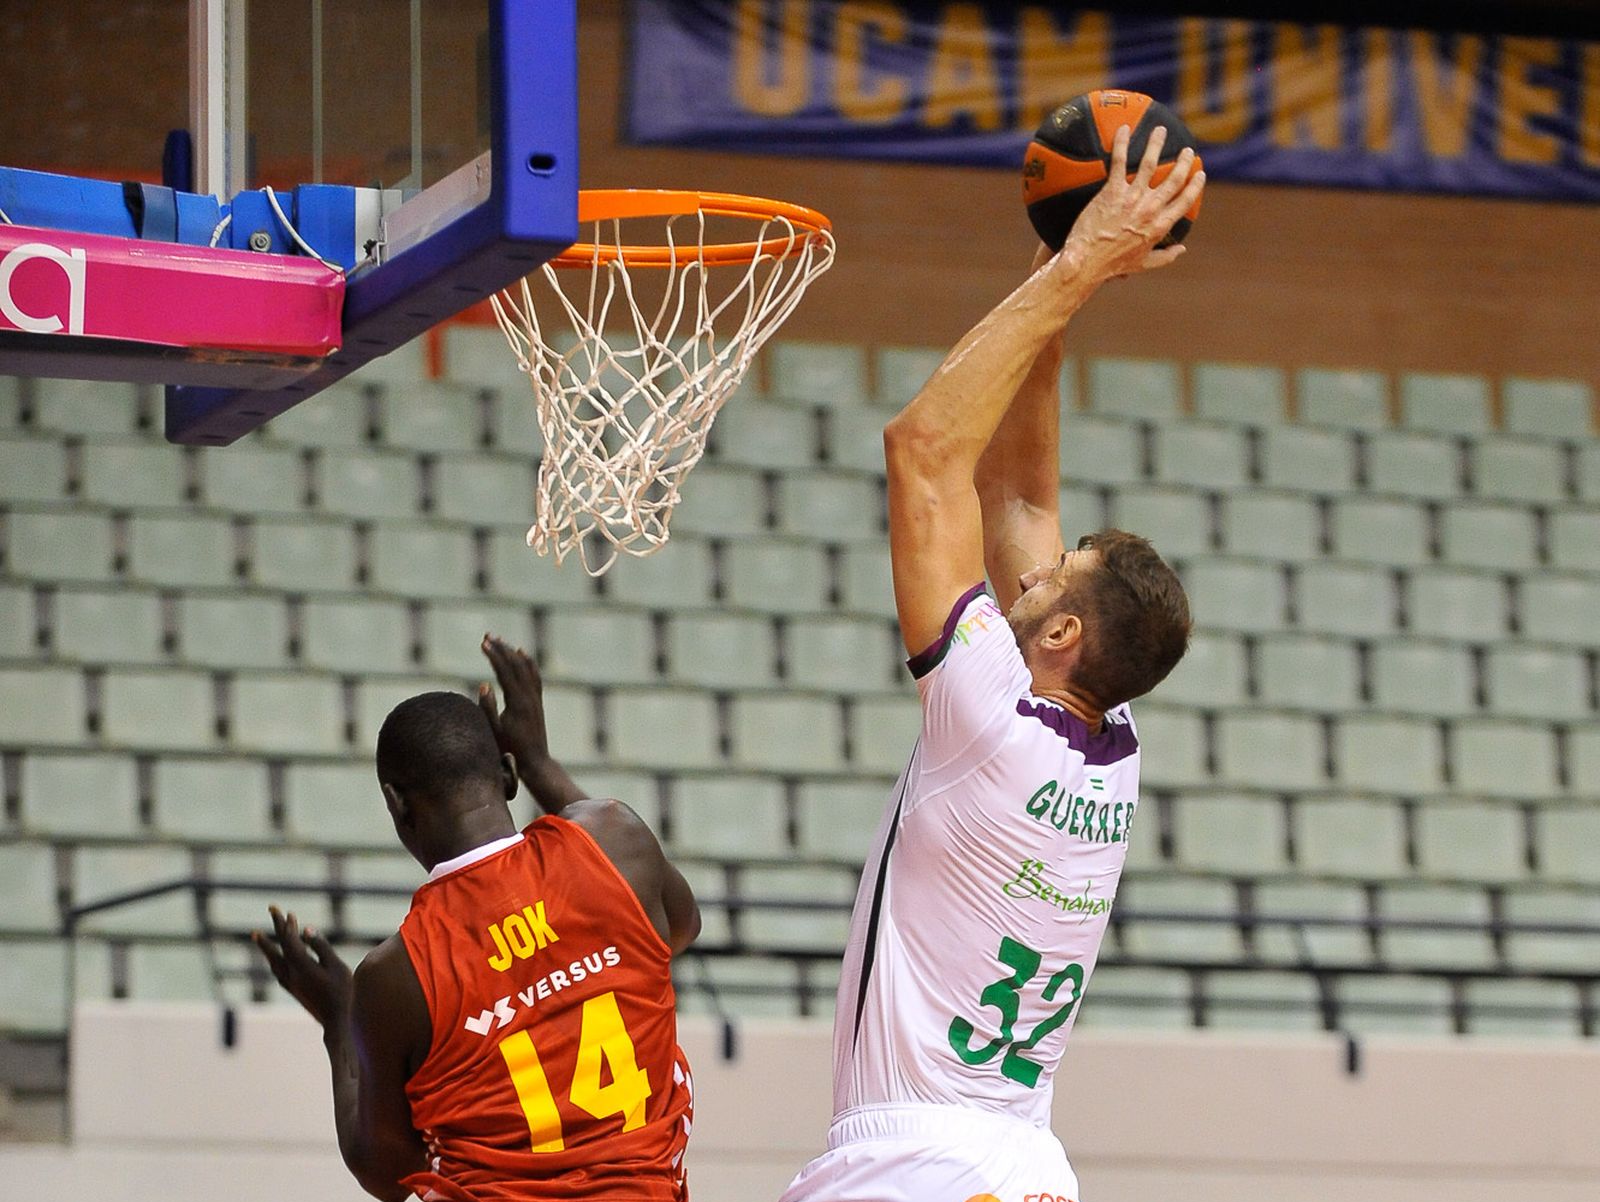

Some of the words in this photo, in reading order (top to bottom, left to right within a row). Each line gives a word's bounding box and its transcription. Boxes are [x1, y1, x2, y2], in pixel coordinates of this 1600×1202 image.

[735, 0, 1112, 130] UCAM
[487, 900, 560, 973] JOK
[517, 946, 621, 1009] VERSUS
[498, 990, 653, 1153] 14
[948, 936, 1084, 1089] 32
